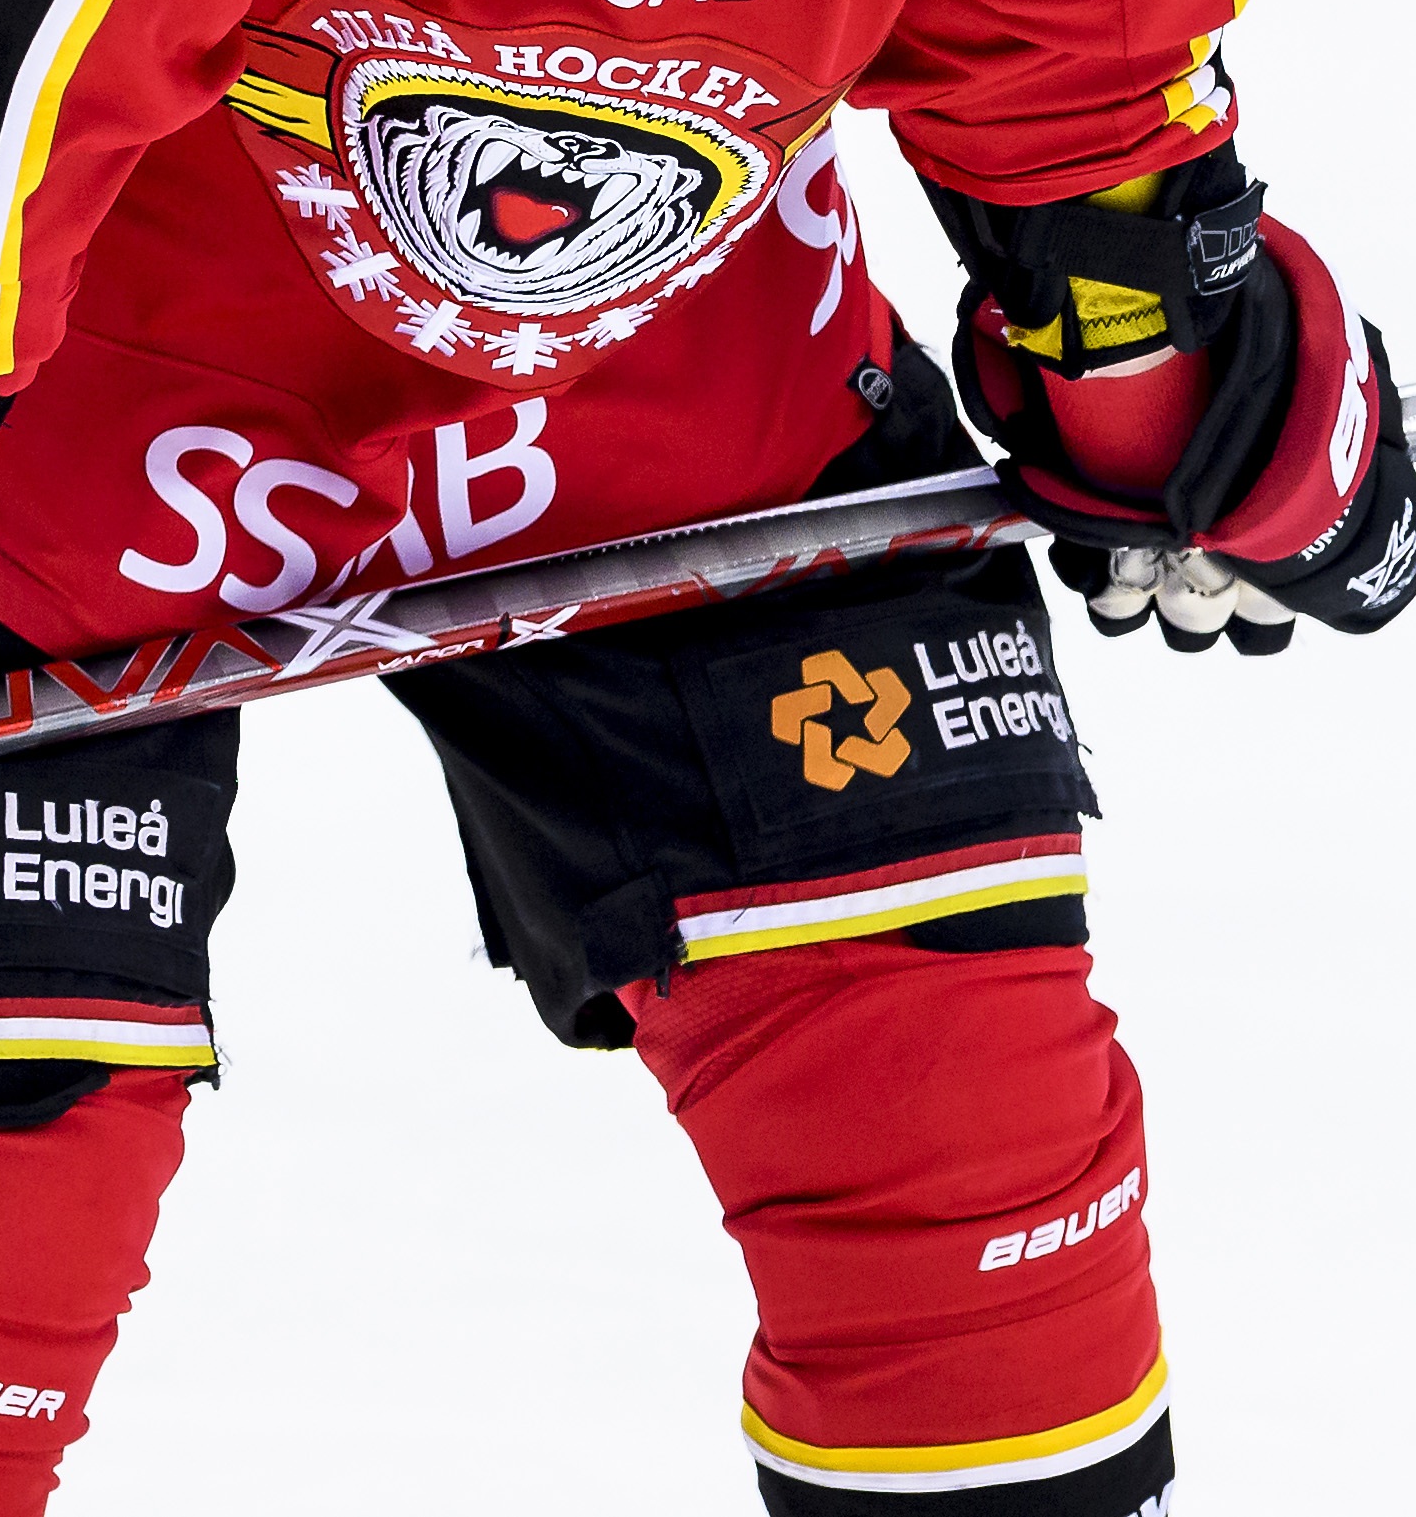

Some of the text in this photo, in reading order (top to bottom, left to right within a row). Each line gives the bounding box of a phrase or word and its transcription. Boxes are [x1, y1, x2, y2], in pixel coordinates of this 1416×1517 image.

[493, 43, 782, 119] HOCKEY
[377, 638, 485, 671] VAPOR
[913, 619, 1043, 691] Luleå
[932, 691, 1073, 751] Energ
[5, 792, 169, 857] Luleå
[978, 1166, 1141, 1272] BAUER
